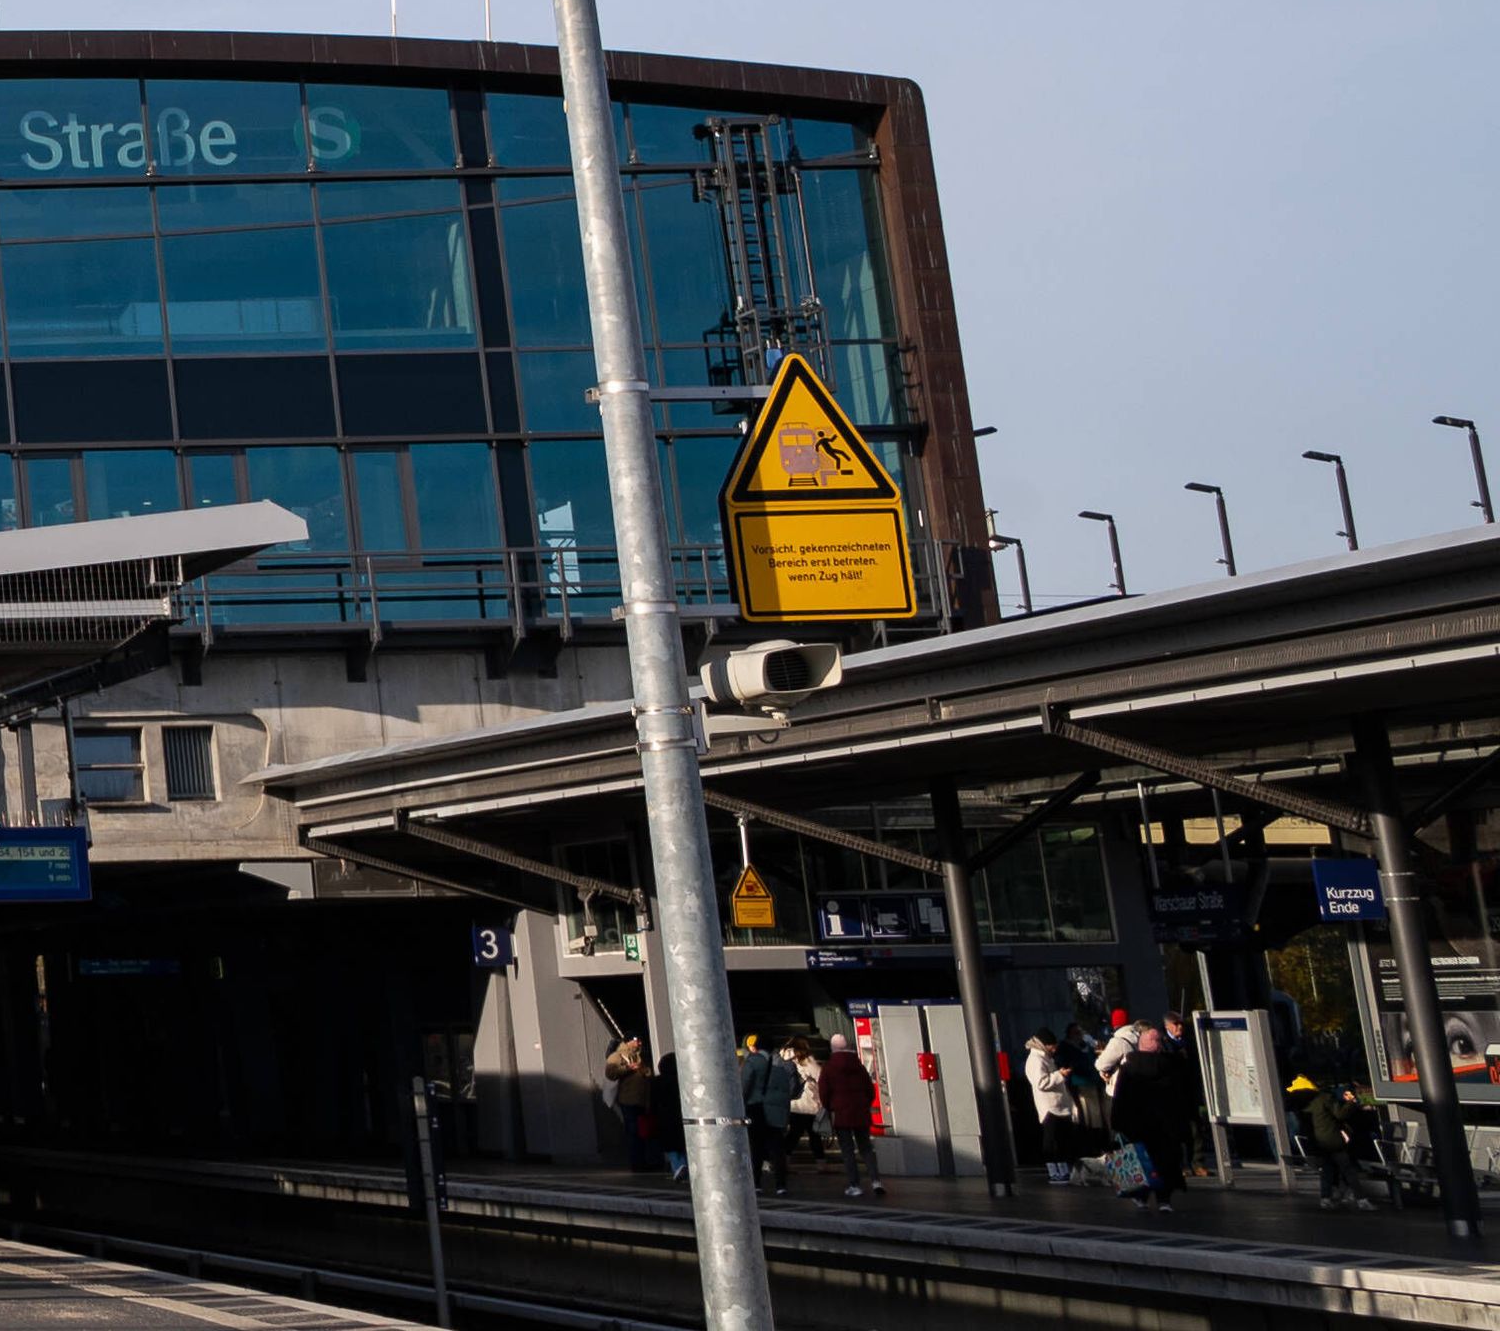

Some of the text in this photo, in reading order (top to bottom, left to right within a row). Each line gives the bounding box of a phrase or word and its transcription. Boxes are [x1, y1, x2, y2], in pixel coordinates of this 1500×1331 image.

[19, 106, 238, 171] Straße
[799, 542, 891, 555] gekennzeichneten
[768, 558, 808, 569] Bereich
[810, 558, 831, 568] erst
[788, 570, 863, 583] wenn Zug hält!
[18, 847, 34, 858] 154
[39, 847, 55, 858] und
[1325, 886, 1375, 901] Kurzzug
[1329, 901, 1360, 914] Ende
[480, 929, 499, 959] 3
